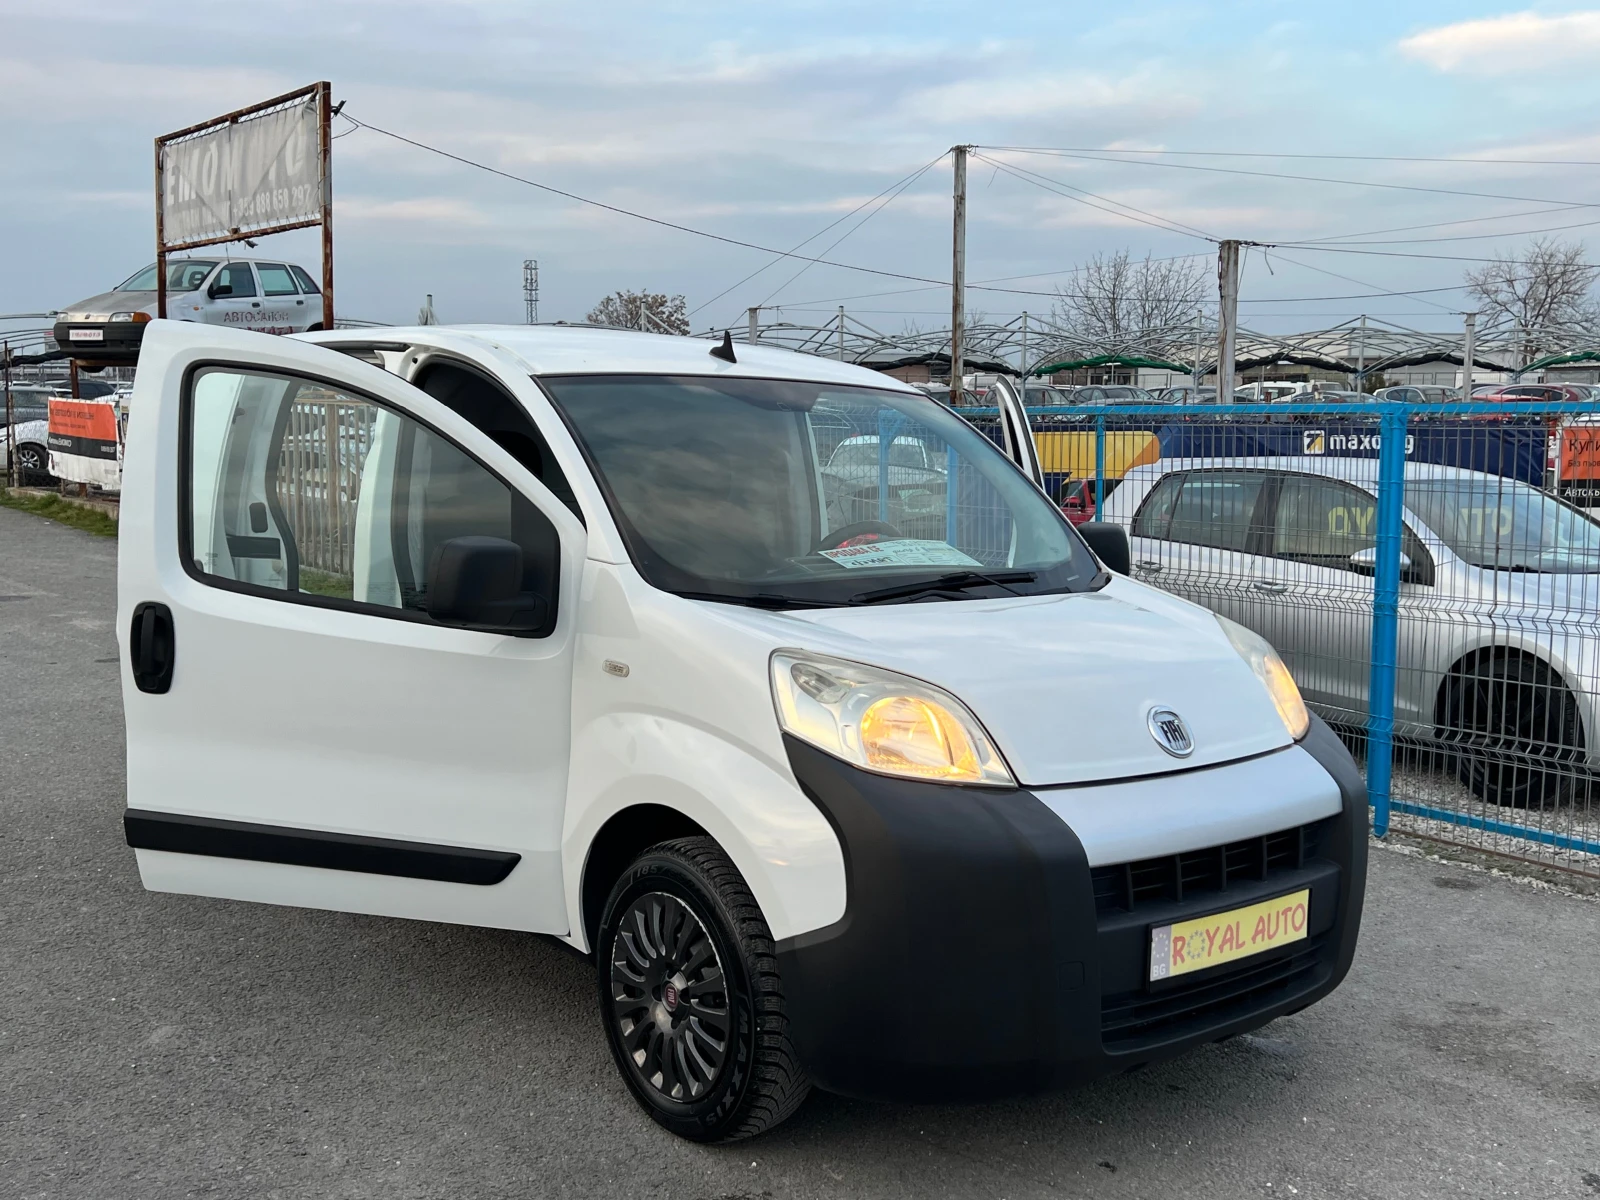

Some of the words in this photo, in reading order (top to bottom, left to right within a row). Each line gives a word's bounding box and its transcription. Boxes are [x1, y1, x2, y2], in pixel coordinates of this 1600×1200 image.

[1172, 921, 1246, 966] ROYAL
[1251, 903, 1306, 944] AUTO
[1152, 963, 1166, 978] BG
